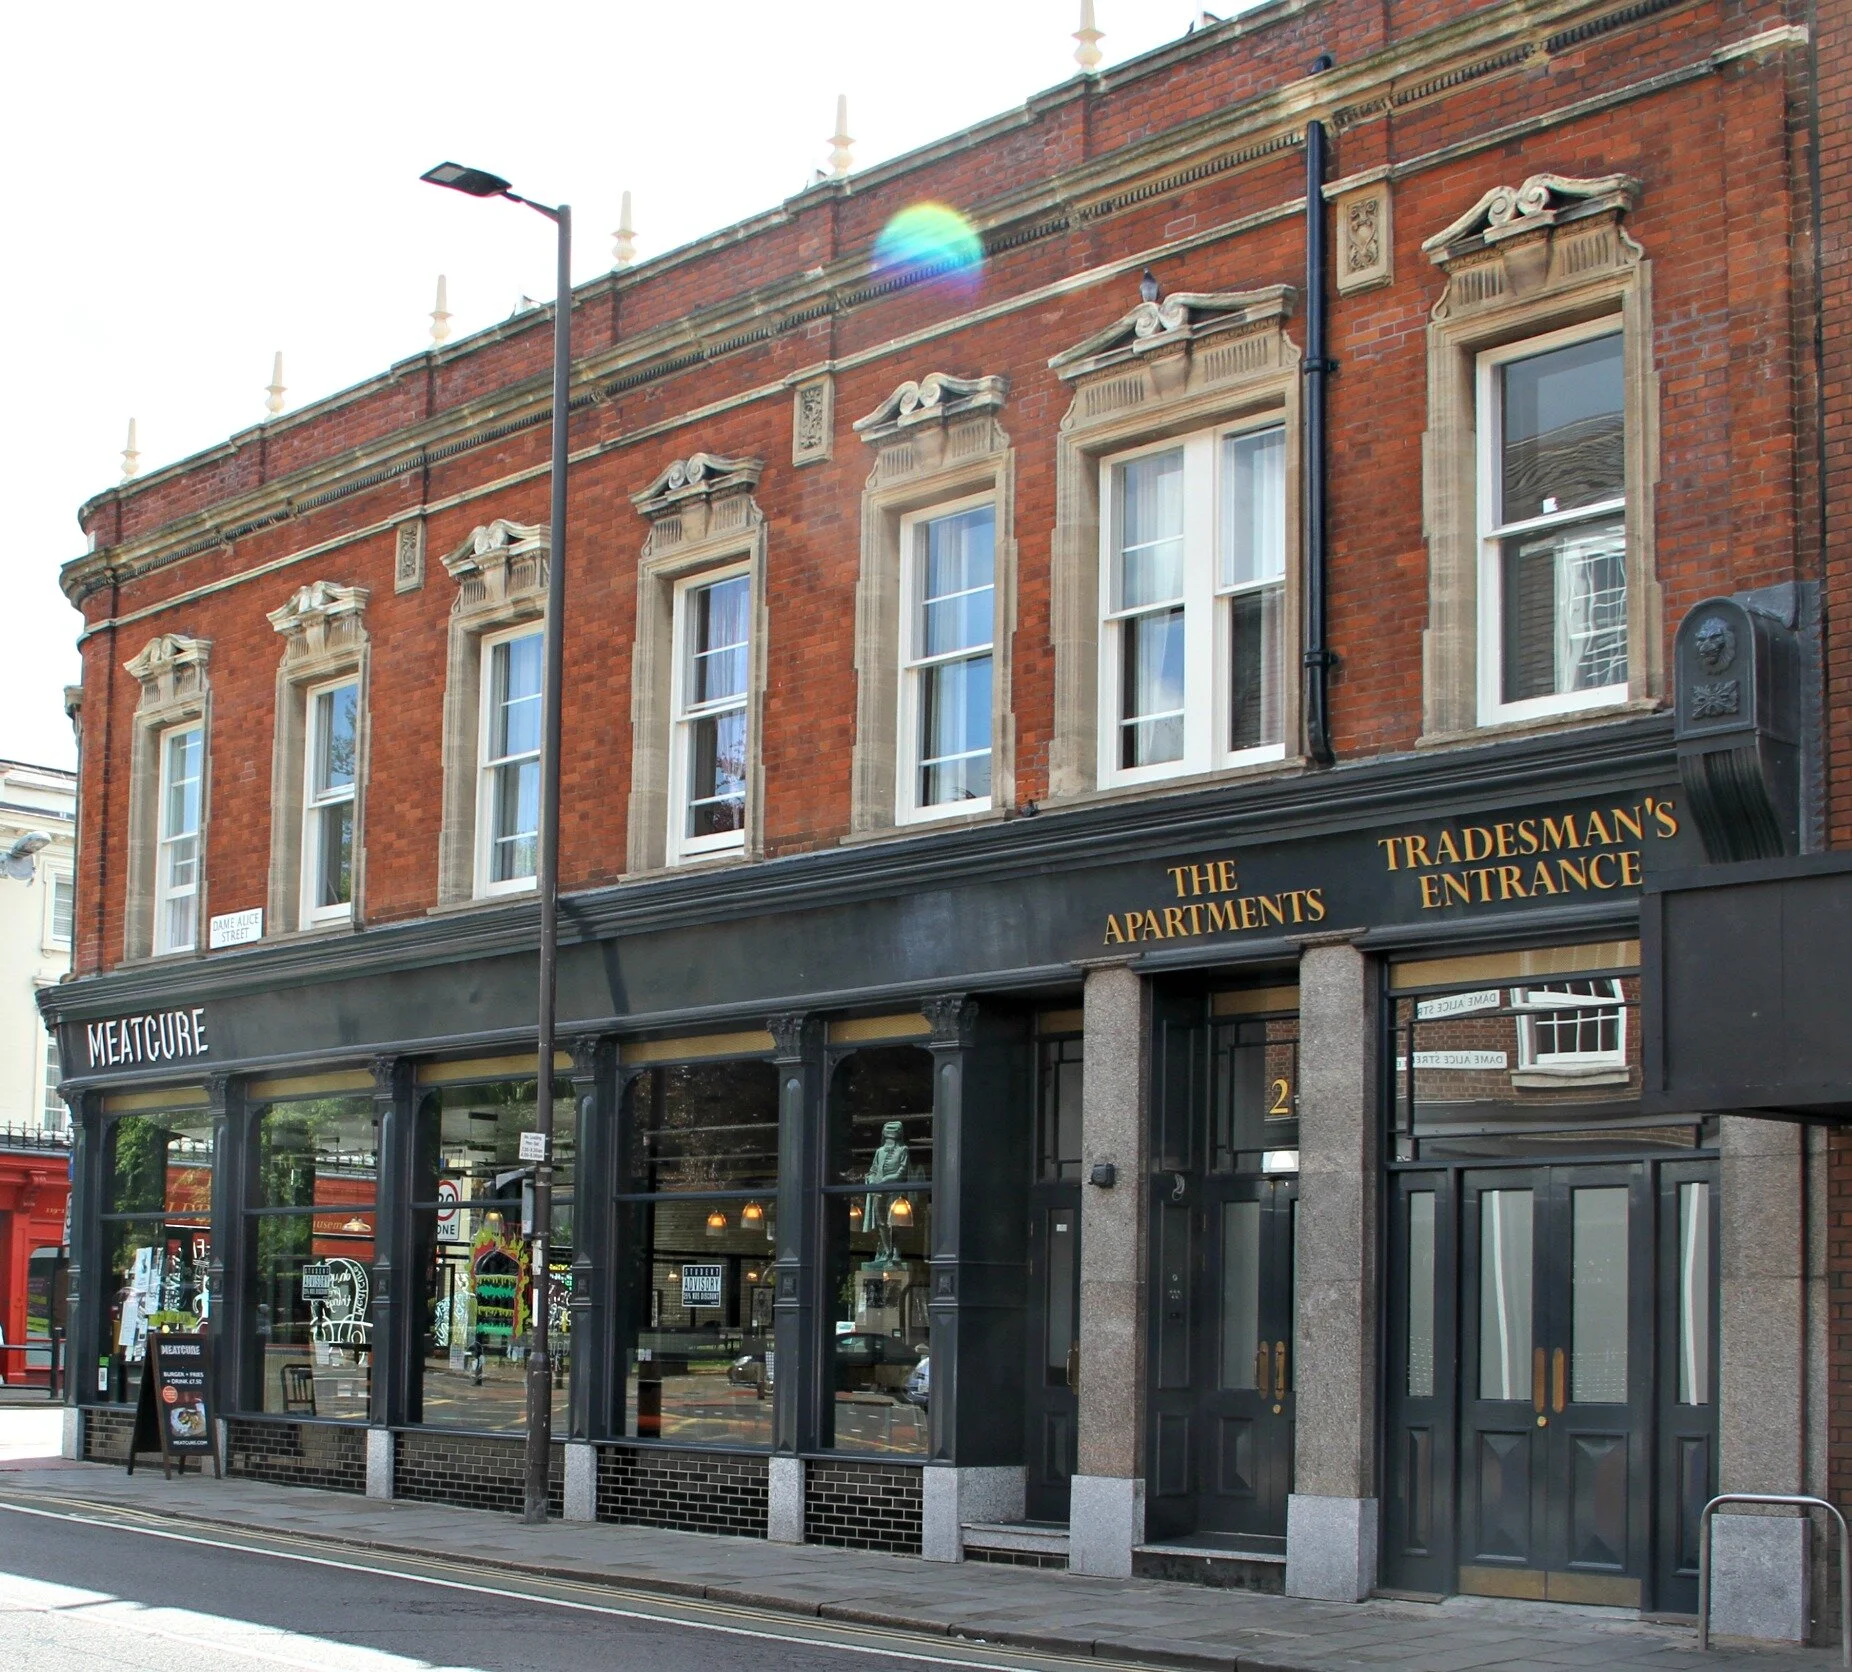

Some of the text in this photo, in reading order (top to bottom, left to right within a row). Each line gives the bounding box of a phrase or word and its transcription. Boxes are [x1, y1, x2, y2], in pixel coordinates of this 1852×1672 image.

[1378, 797, 1680, 872] TRADESMAN'S
[1167, 859, 1239, 898] THE
[1418, 850, 1644, 909] ENTRANCE
[213, 913, 259, 931] DAME ALICE
[1103, 888, 1326, 945] APARTMENTS
[222, 927, 249, 942] STREET
[87, 1008, 209, 1068] MEATCURE
[1269, 1079, 1289, 1114] 2
[437, 1225, 455, 1235] ONE
[685, 1267, 719, 1276] STUDENT
[684, 1277, 720, 1291] ADVISORY
[700, 1292, 719, 1301] DISCOUNT
[161, 1345, 201, 1355] MEATCURE
